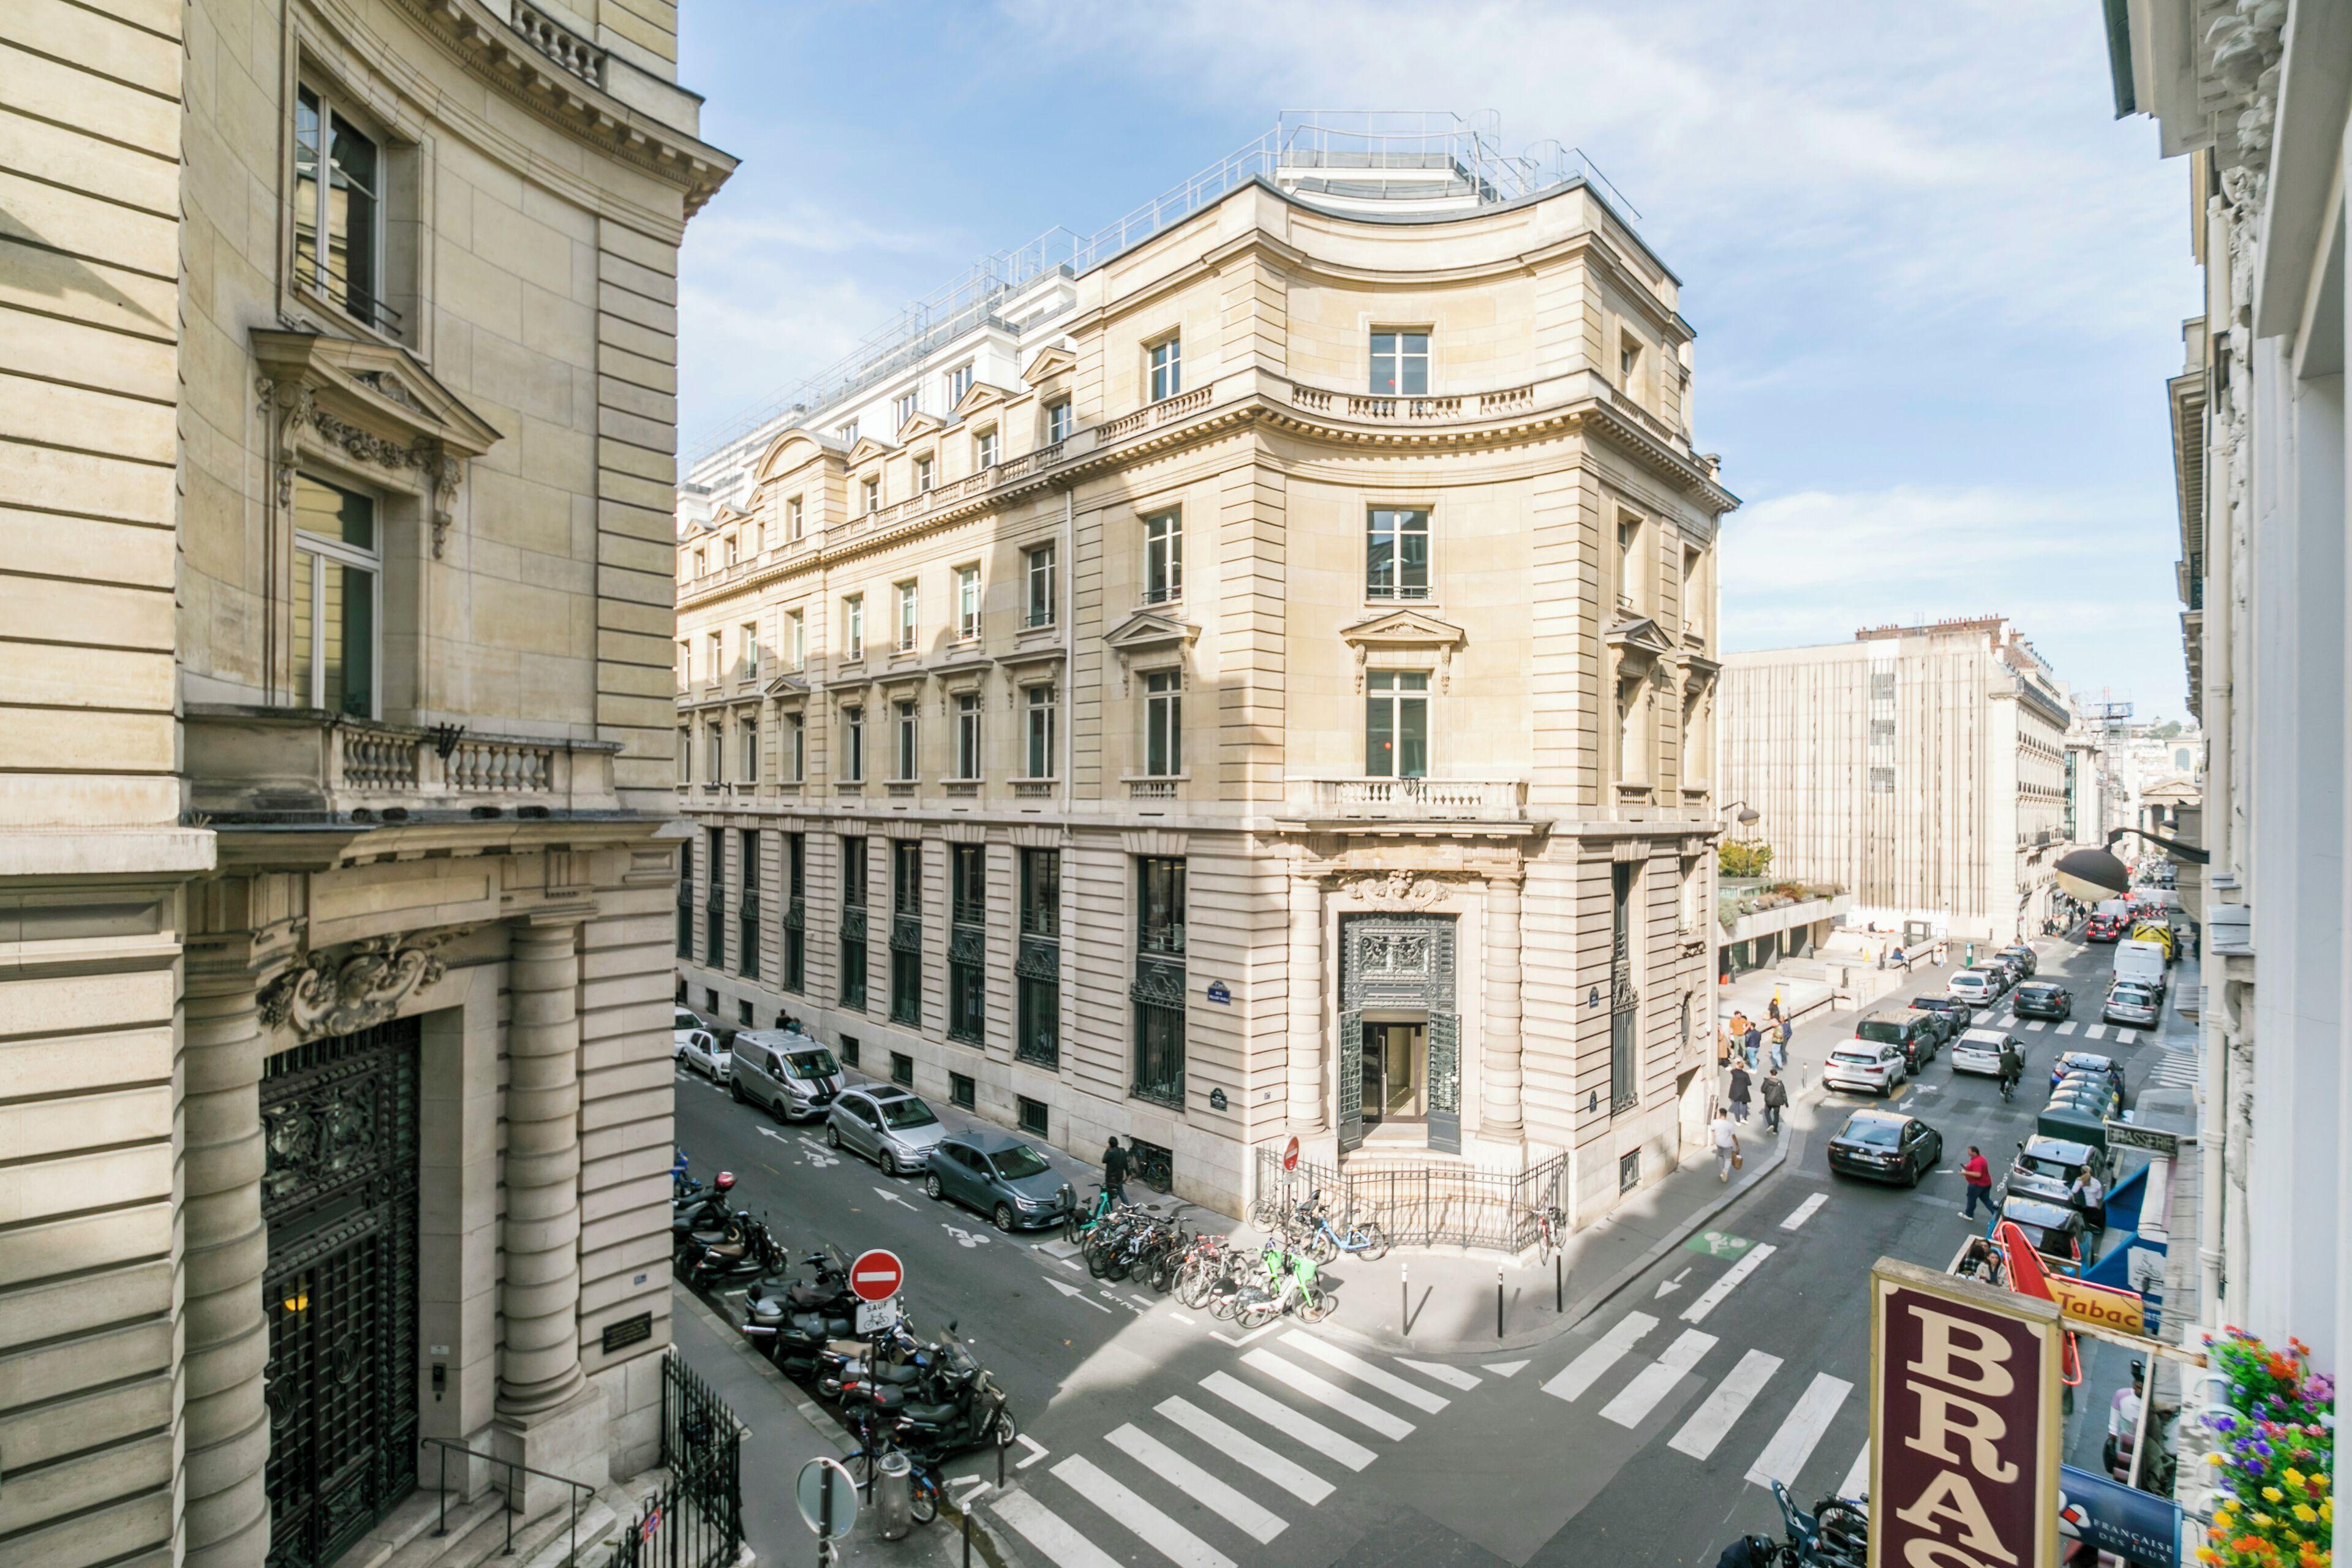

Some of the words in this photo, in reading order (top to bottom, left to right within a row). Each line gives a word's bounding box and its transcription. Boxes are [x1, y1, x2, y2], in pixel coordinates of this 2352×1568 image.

[2108, 1128, 2176, 1151] BRASSERIE
[866, 1301, 888, 1313] SAUF
[2057, 1291, 2138, 1327] Tabac
[2094, 1518, 2173, 1554] FRANÇAISE
[2098, 1532, 2125, 1547] DES
